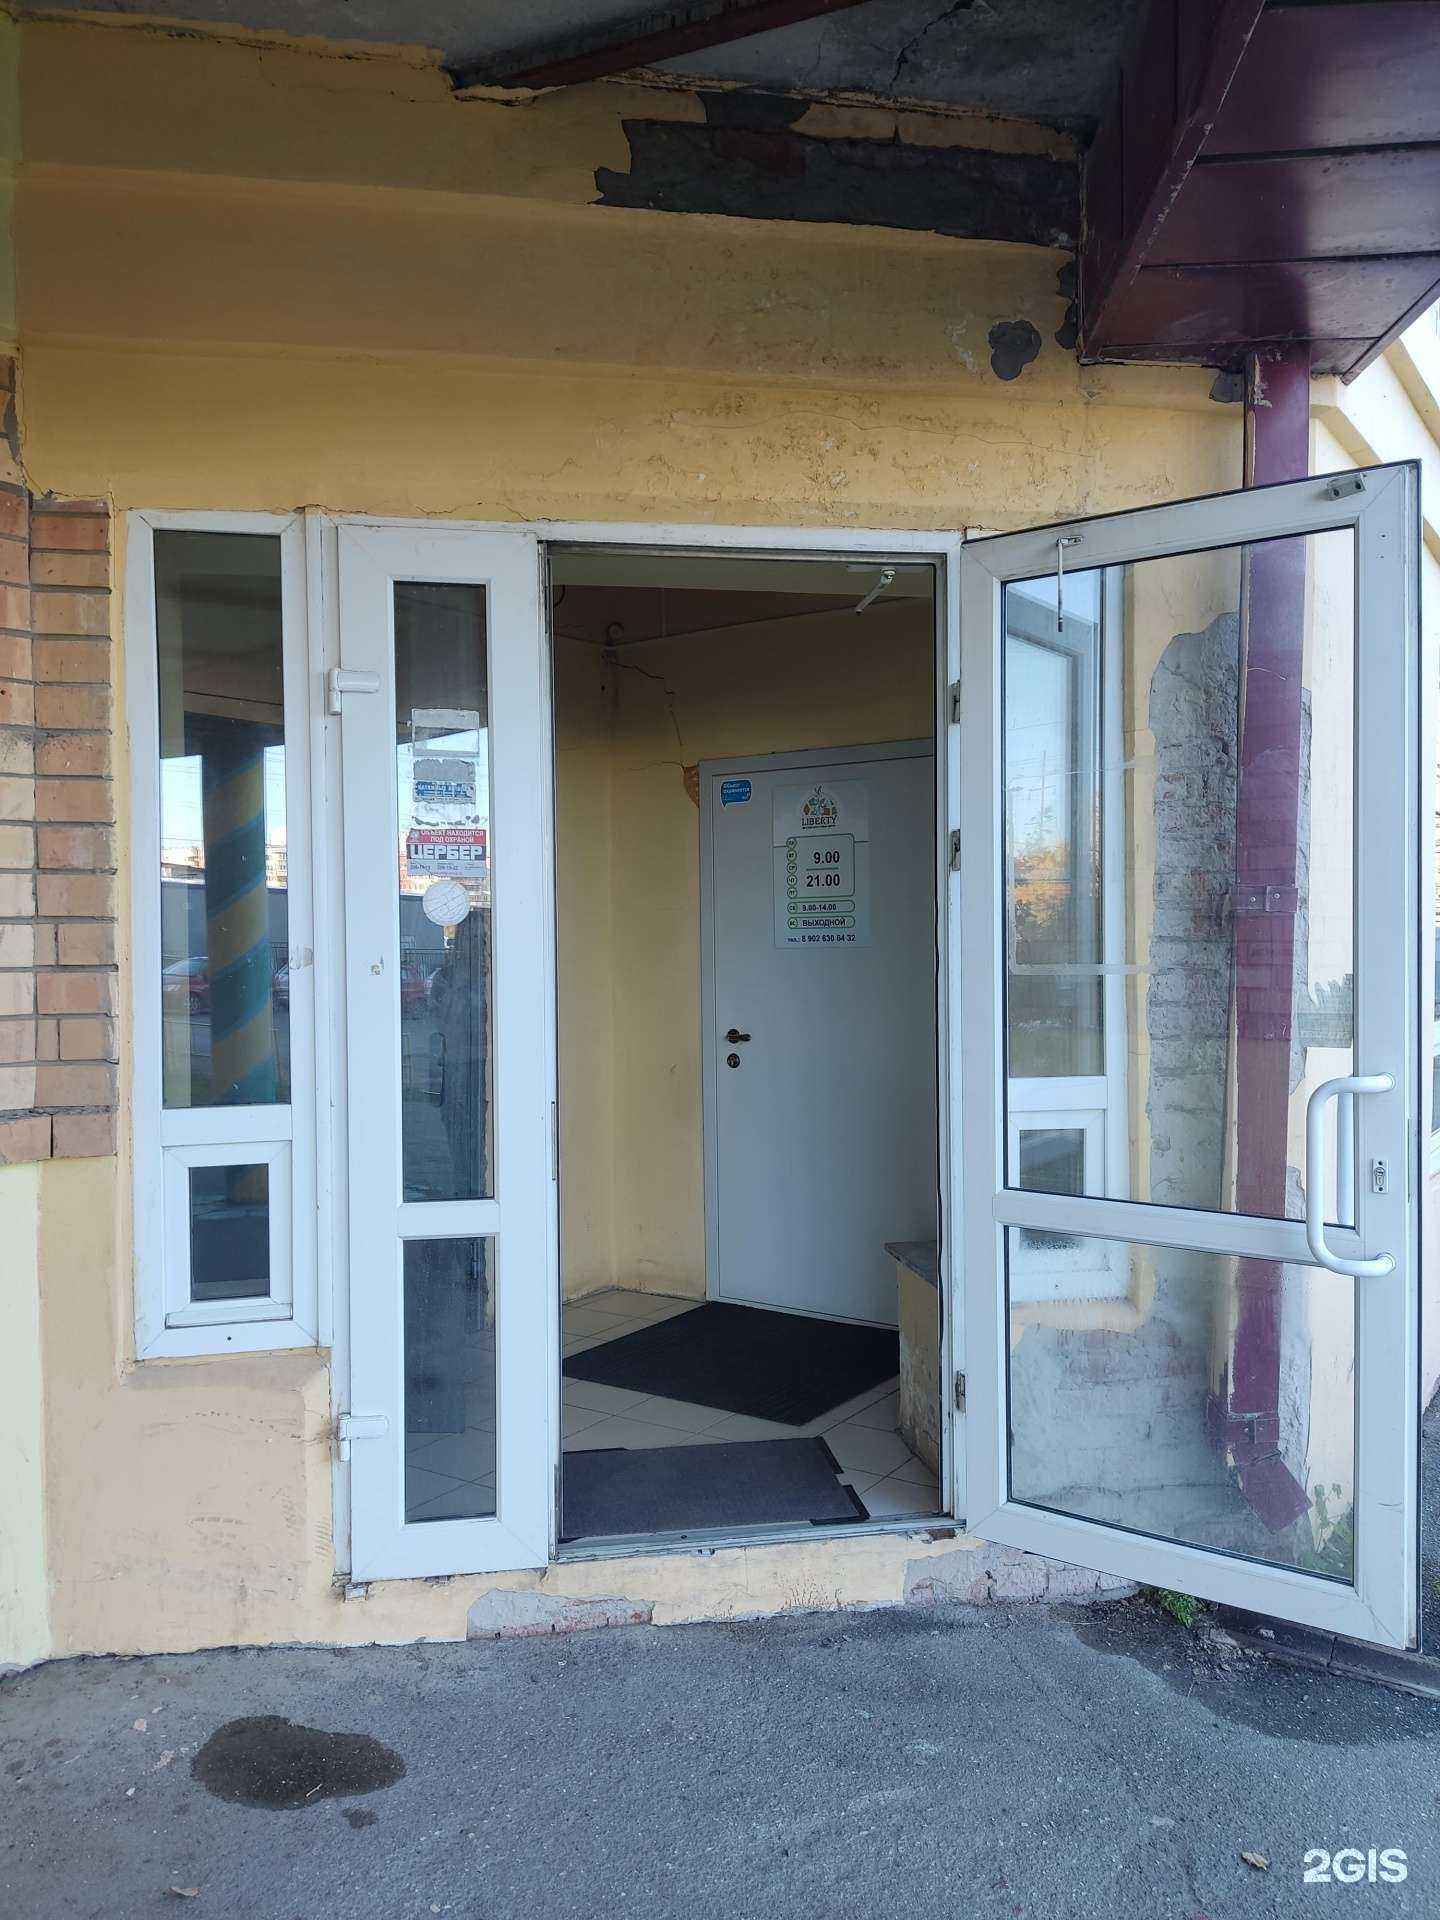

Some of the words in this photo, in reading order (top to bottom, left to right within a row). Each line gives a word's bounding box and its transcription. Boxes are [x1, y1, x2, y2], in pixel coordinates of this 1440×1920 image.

[801, 815, 838, 826] LIBERTY
[410, 844, 483, 860] ЦЕРБЕР
[813, 851, 840, 864] 9.00
[806, 874, 840, 887] 21.00
[802, 917, 846, 928] ВЫХОДНОЙ
